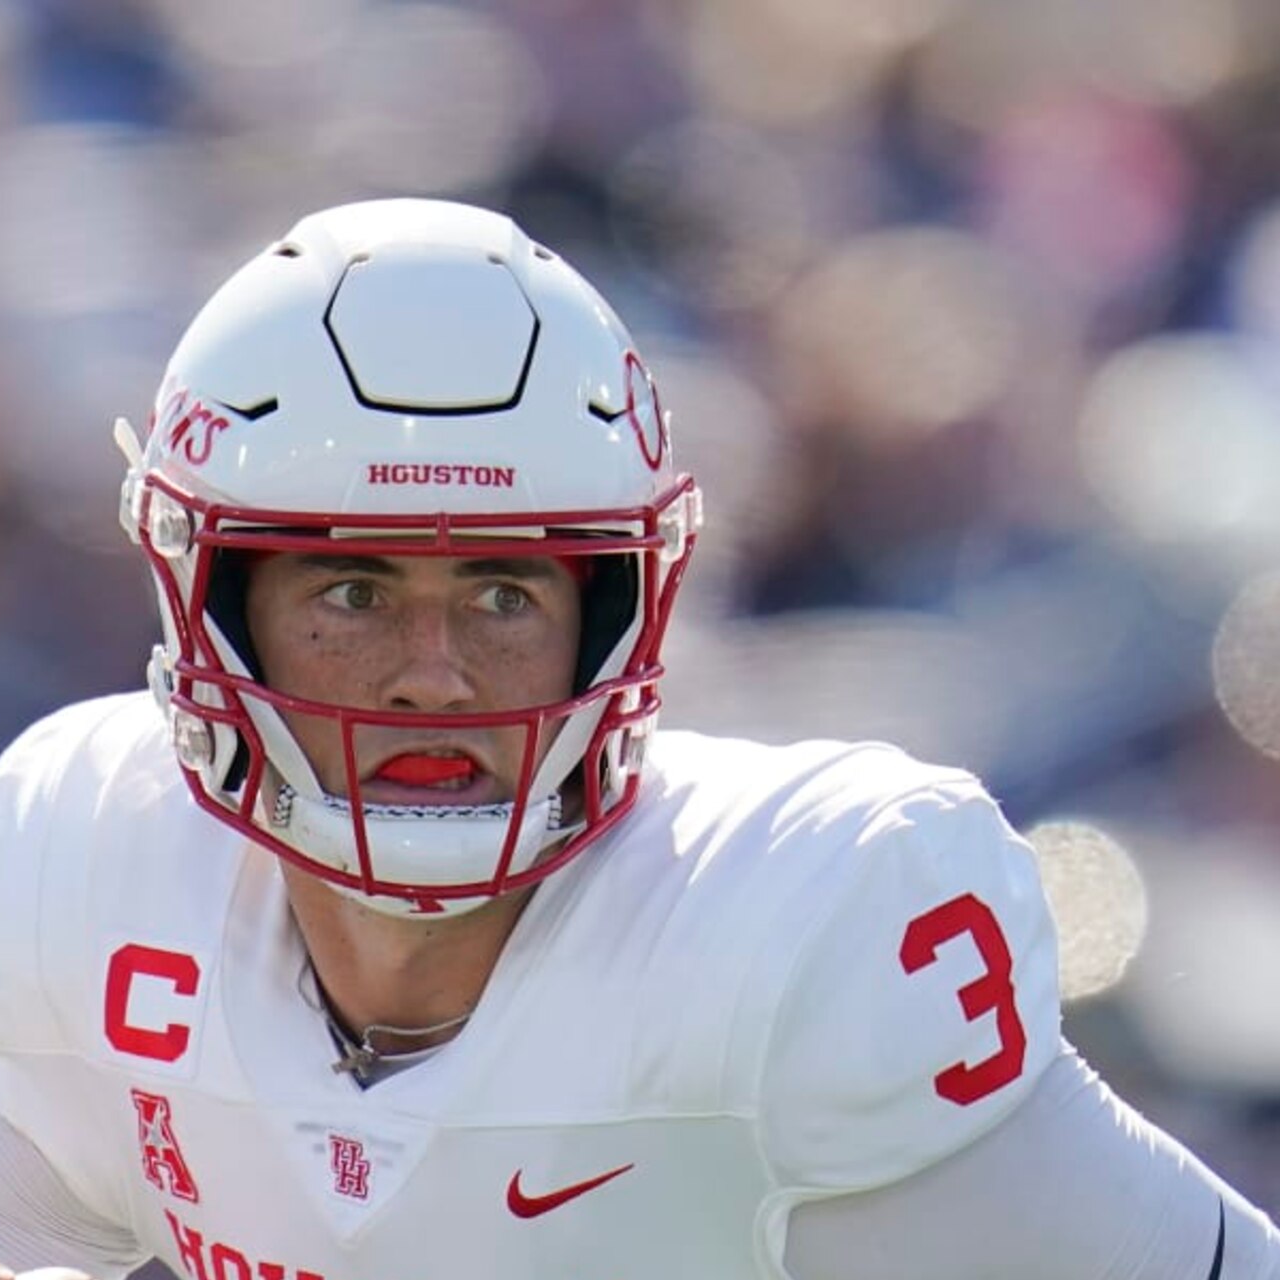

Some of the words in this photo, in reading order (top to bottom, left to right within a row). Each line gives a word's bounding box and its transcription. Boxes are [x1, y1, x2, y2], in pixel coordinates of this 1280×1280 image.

[368, 463, 516, 488] HOUSTON
[104, 943, 201, 1062] C
[899, 892, 1027, 1106] 3
